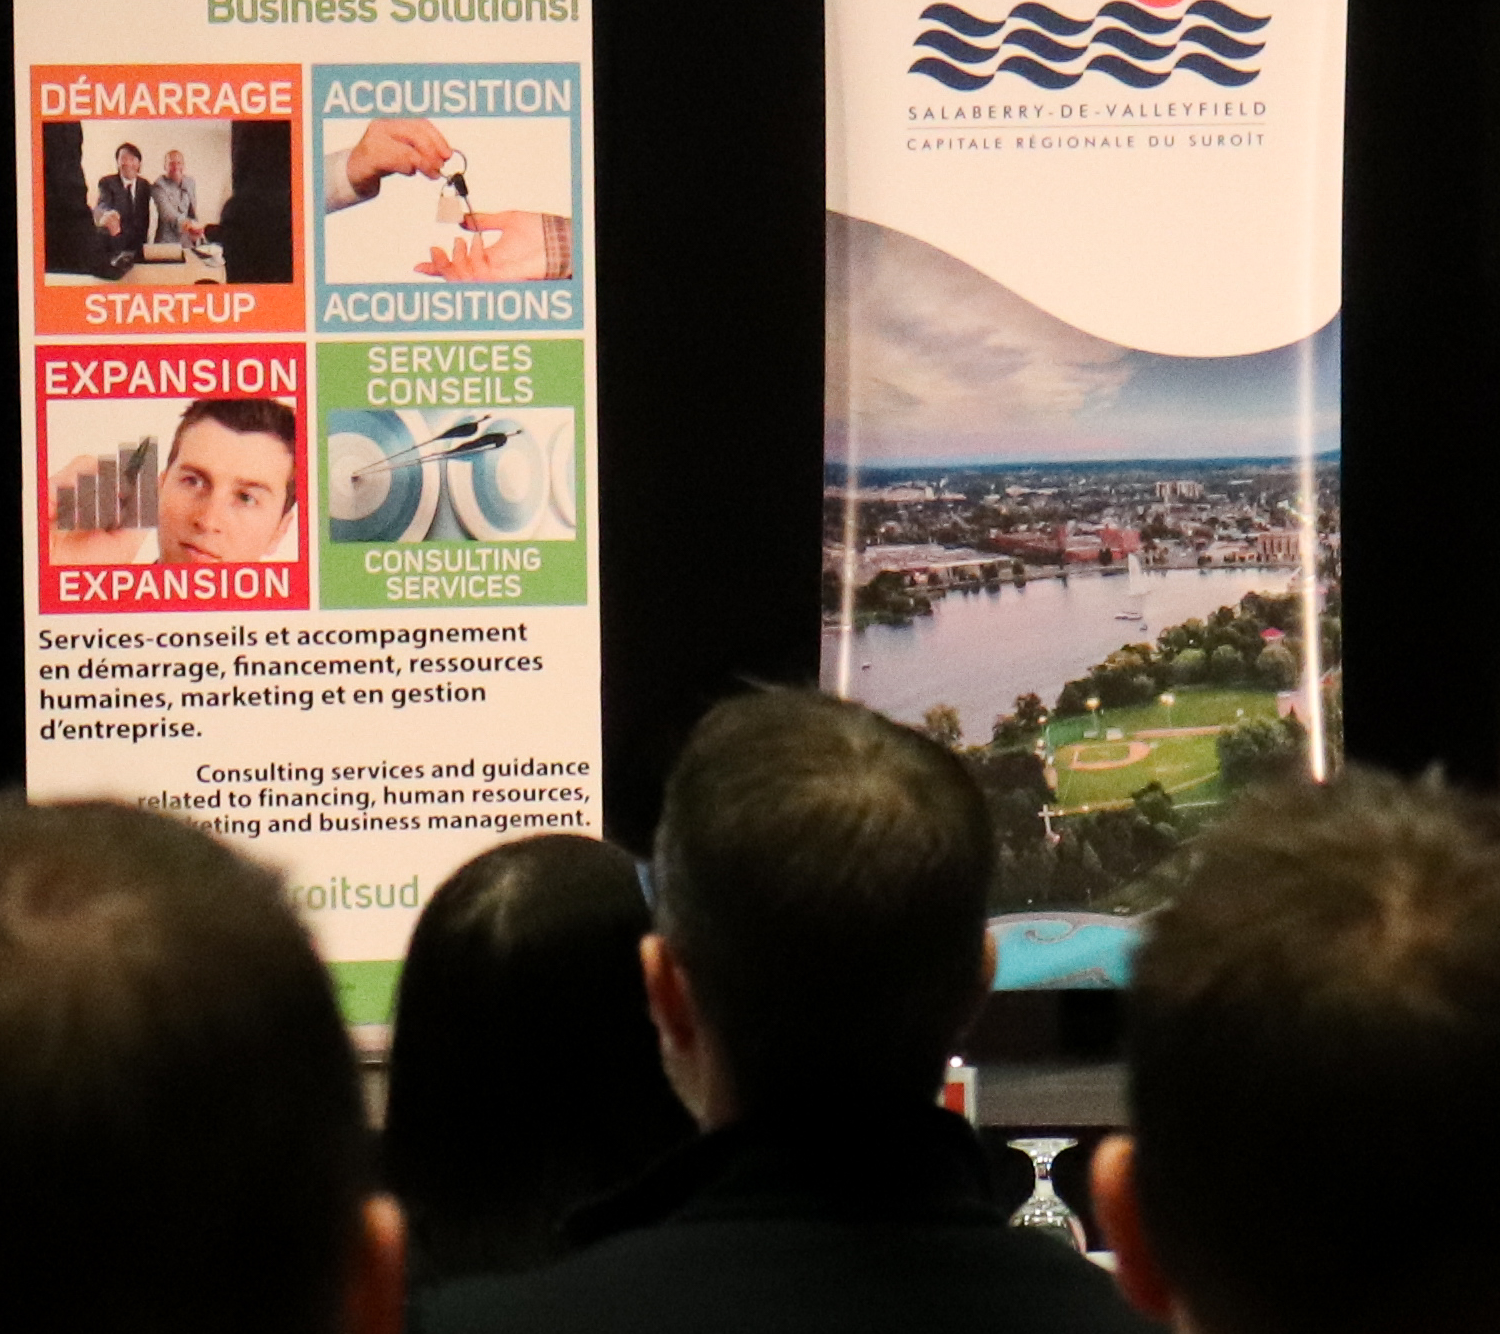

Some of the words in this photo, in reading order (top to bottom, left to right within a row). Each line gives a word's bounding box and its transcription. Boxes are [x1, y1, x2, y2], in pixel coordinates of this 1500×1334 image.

[41, 75, 292, 115] DÉMARRAGE
[324, 79, 571, 113] ACQUISITION
[908, 102, 1266, 120] SALABERRY-DE-VALLEYFIELD
[907, 137, 1001, 151] CAPITALE
[1016, 135, 1134, 149] RÉGIONALE
[1148, 135, 1175, 147] DU
[86, 292, 256, 324] START-UP
[324, 290, 572, 322] ACQUISITIONS
[369, 344, 532, 373] SERVICES
[46, 359, 297, 394] EXPANSION
[368, 376, 533, 405] CONSEILS
[365, 547, 541, 573] CONSULTING
[60, 568, 289, 601] EXPANSION
[387, 575, 521, 600] SERVICES
[39, 626, 258, 650] Services-conseils
[265, 627, 289, 646] et
[297, 623, 527, 649] accompagnement
[39, 665, 69, 680] en
[78, 658, 225, 683] démarrage,
[234, 655, 401, 676] financement,
[410, 656, 543, 673] ressources
[40, 688, 172, 710] humaines,
[182, 685, 313, 711] marketing
[322, 686, 345, 704] et
[353, 689, 383, 704] en
[391, 682, 485, 709] gestion
[197, 762, 323, 786] Consulting
[332, 761, 424, 780] services
[431, 758, 474, 778] and
[482, 757, 590, 782] guidance
[137, 790, 221, 810] related
[228, 792, 252, 808] to
[259, 787, 375, 810] financing,
[384, 786, 464, 804] human
[472, 787, 589, 803] resources,
[268, 813, 312, 832] and
[320, 812, 420, 831] business
[428, 810, 590, 833] management.
